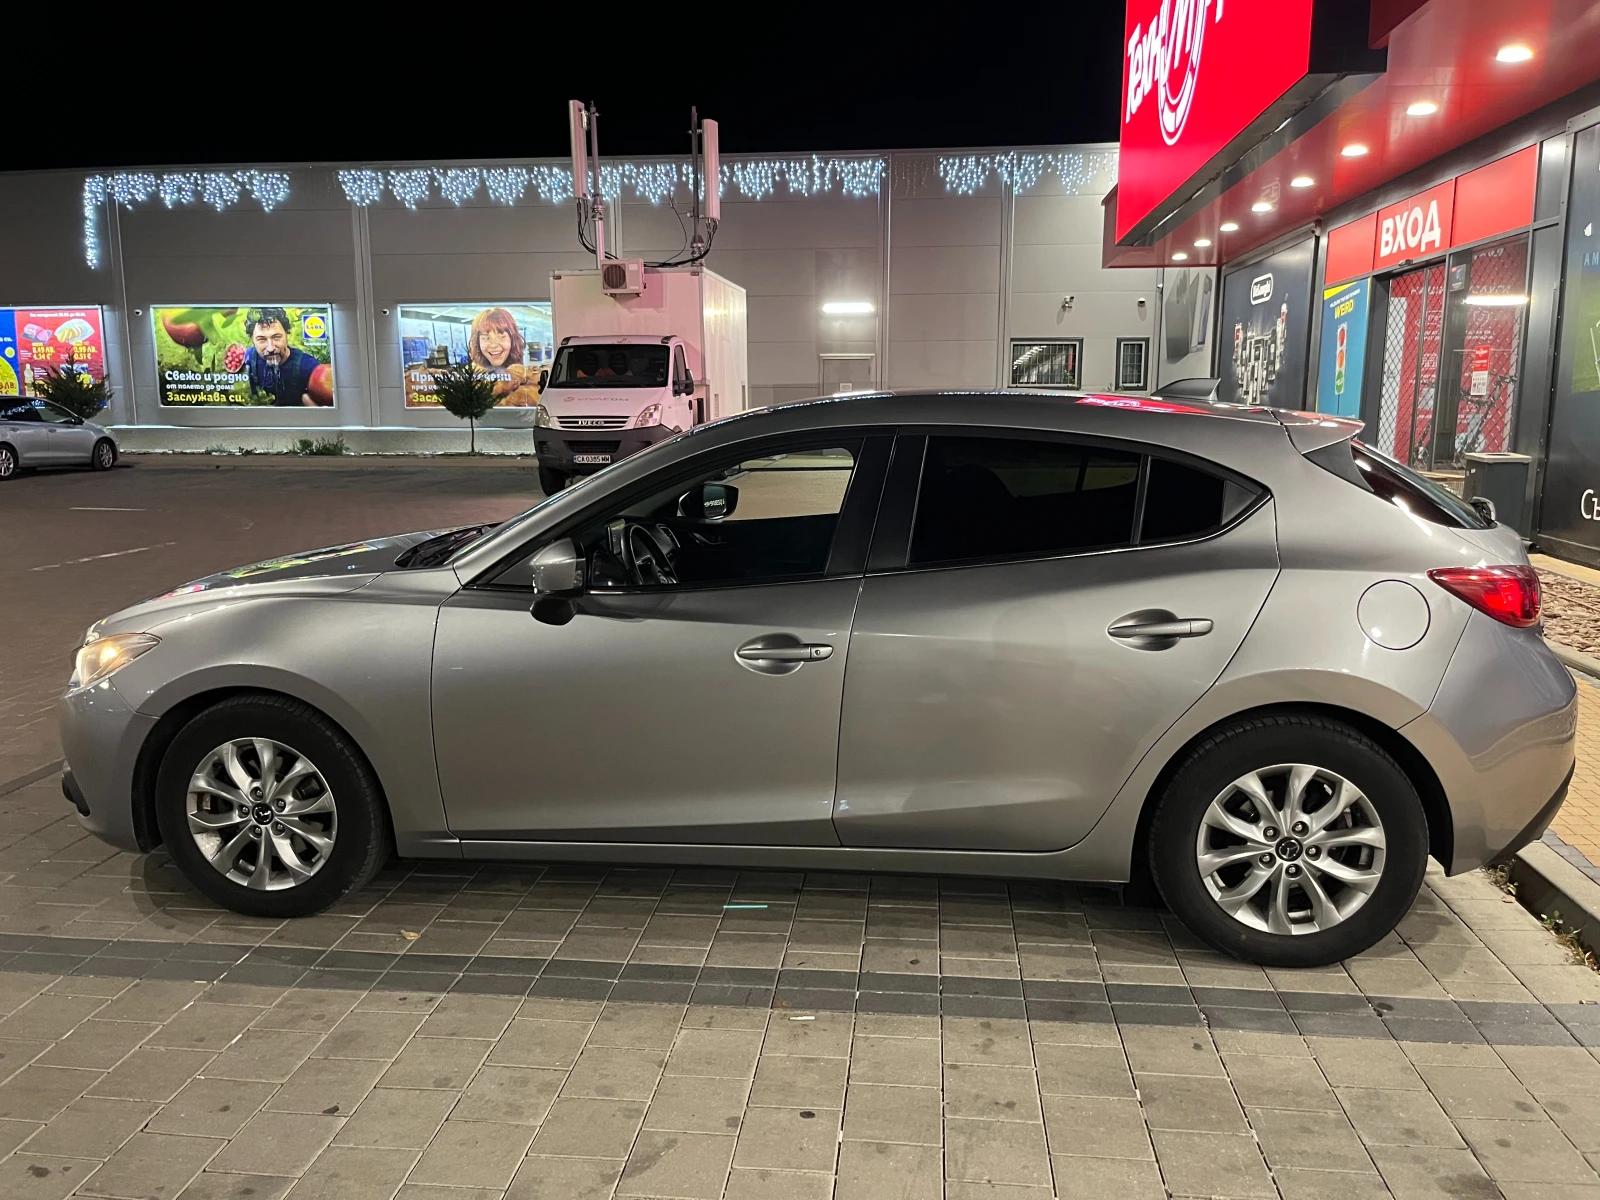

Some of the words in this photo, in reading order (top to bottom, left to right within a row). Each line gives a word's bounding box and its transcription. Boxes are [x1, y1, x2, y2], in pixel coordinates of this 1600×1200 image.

[1380, 199, 1441, 258] ВХОД
[165, 370, 202, 381] Свежо
[204, 373, 211, 381] и
[213, 373, 249, 383] родно
[166, 392, 227, 404] Заслужава
[228, 394, 245, 402] си.
